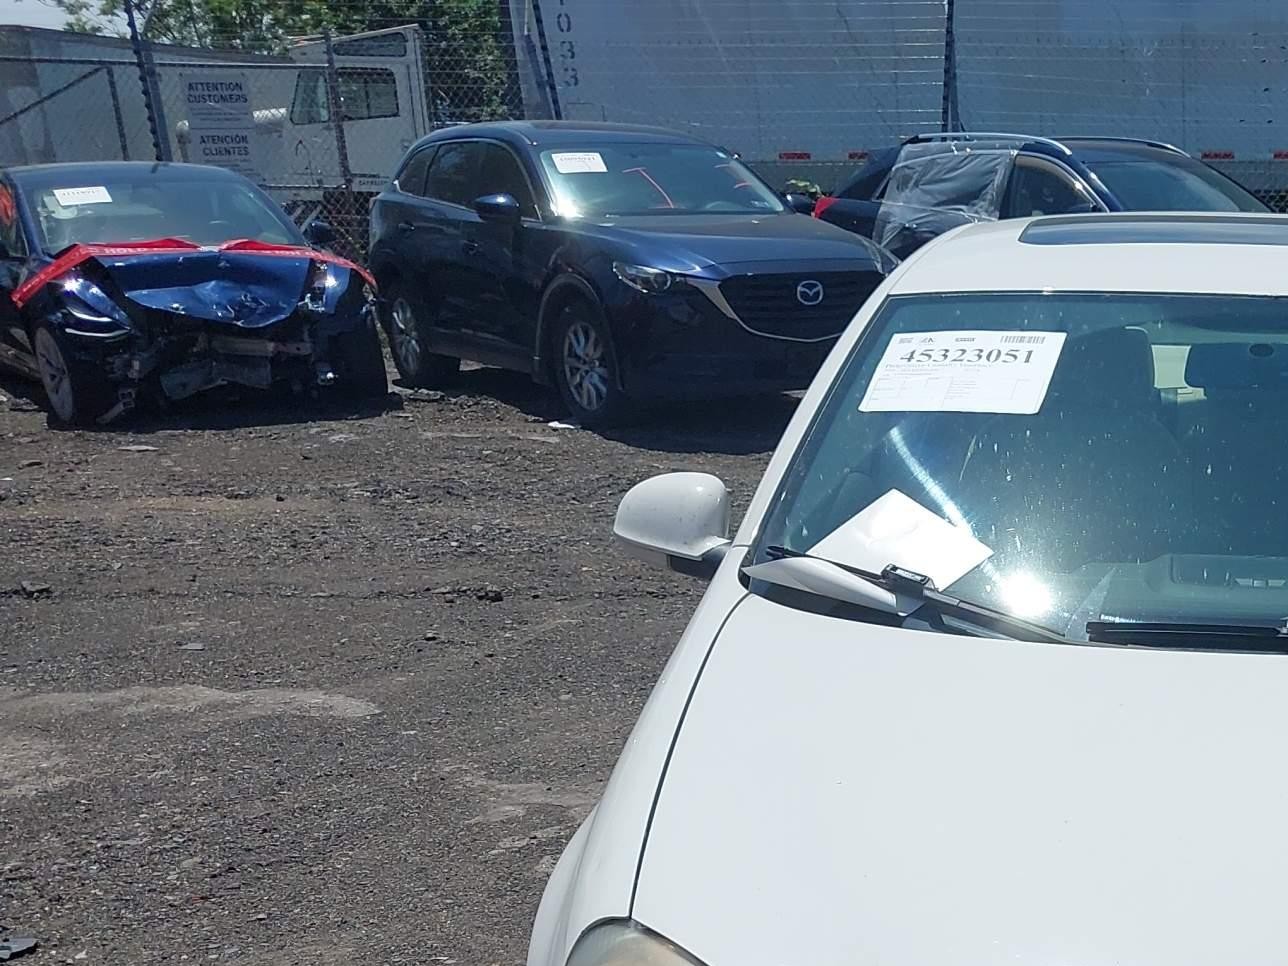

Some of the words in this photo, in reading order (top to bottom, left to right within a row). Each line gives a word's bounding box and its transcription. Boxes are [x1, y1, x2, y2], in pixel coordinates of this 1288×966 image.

[188, 82, 242, 92] ATTENTION
[187, 94, 248, 103] CUSTOMERS
[202, 147, 249, 156] CLIENTES
[900, 348, 1034, 364] 45323051
